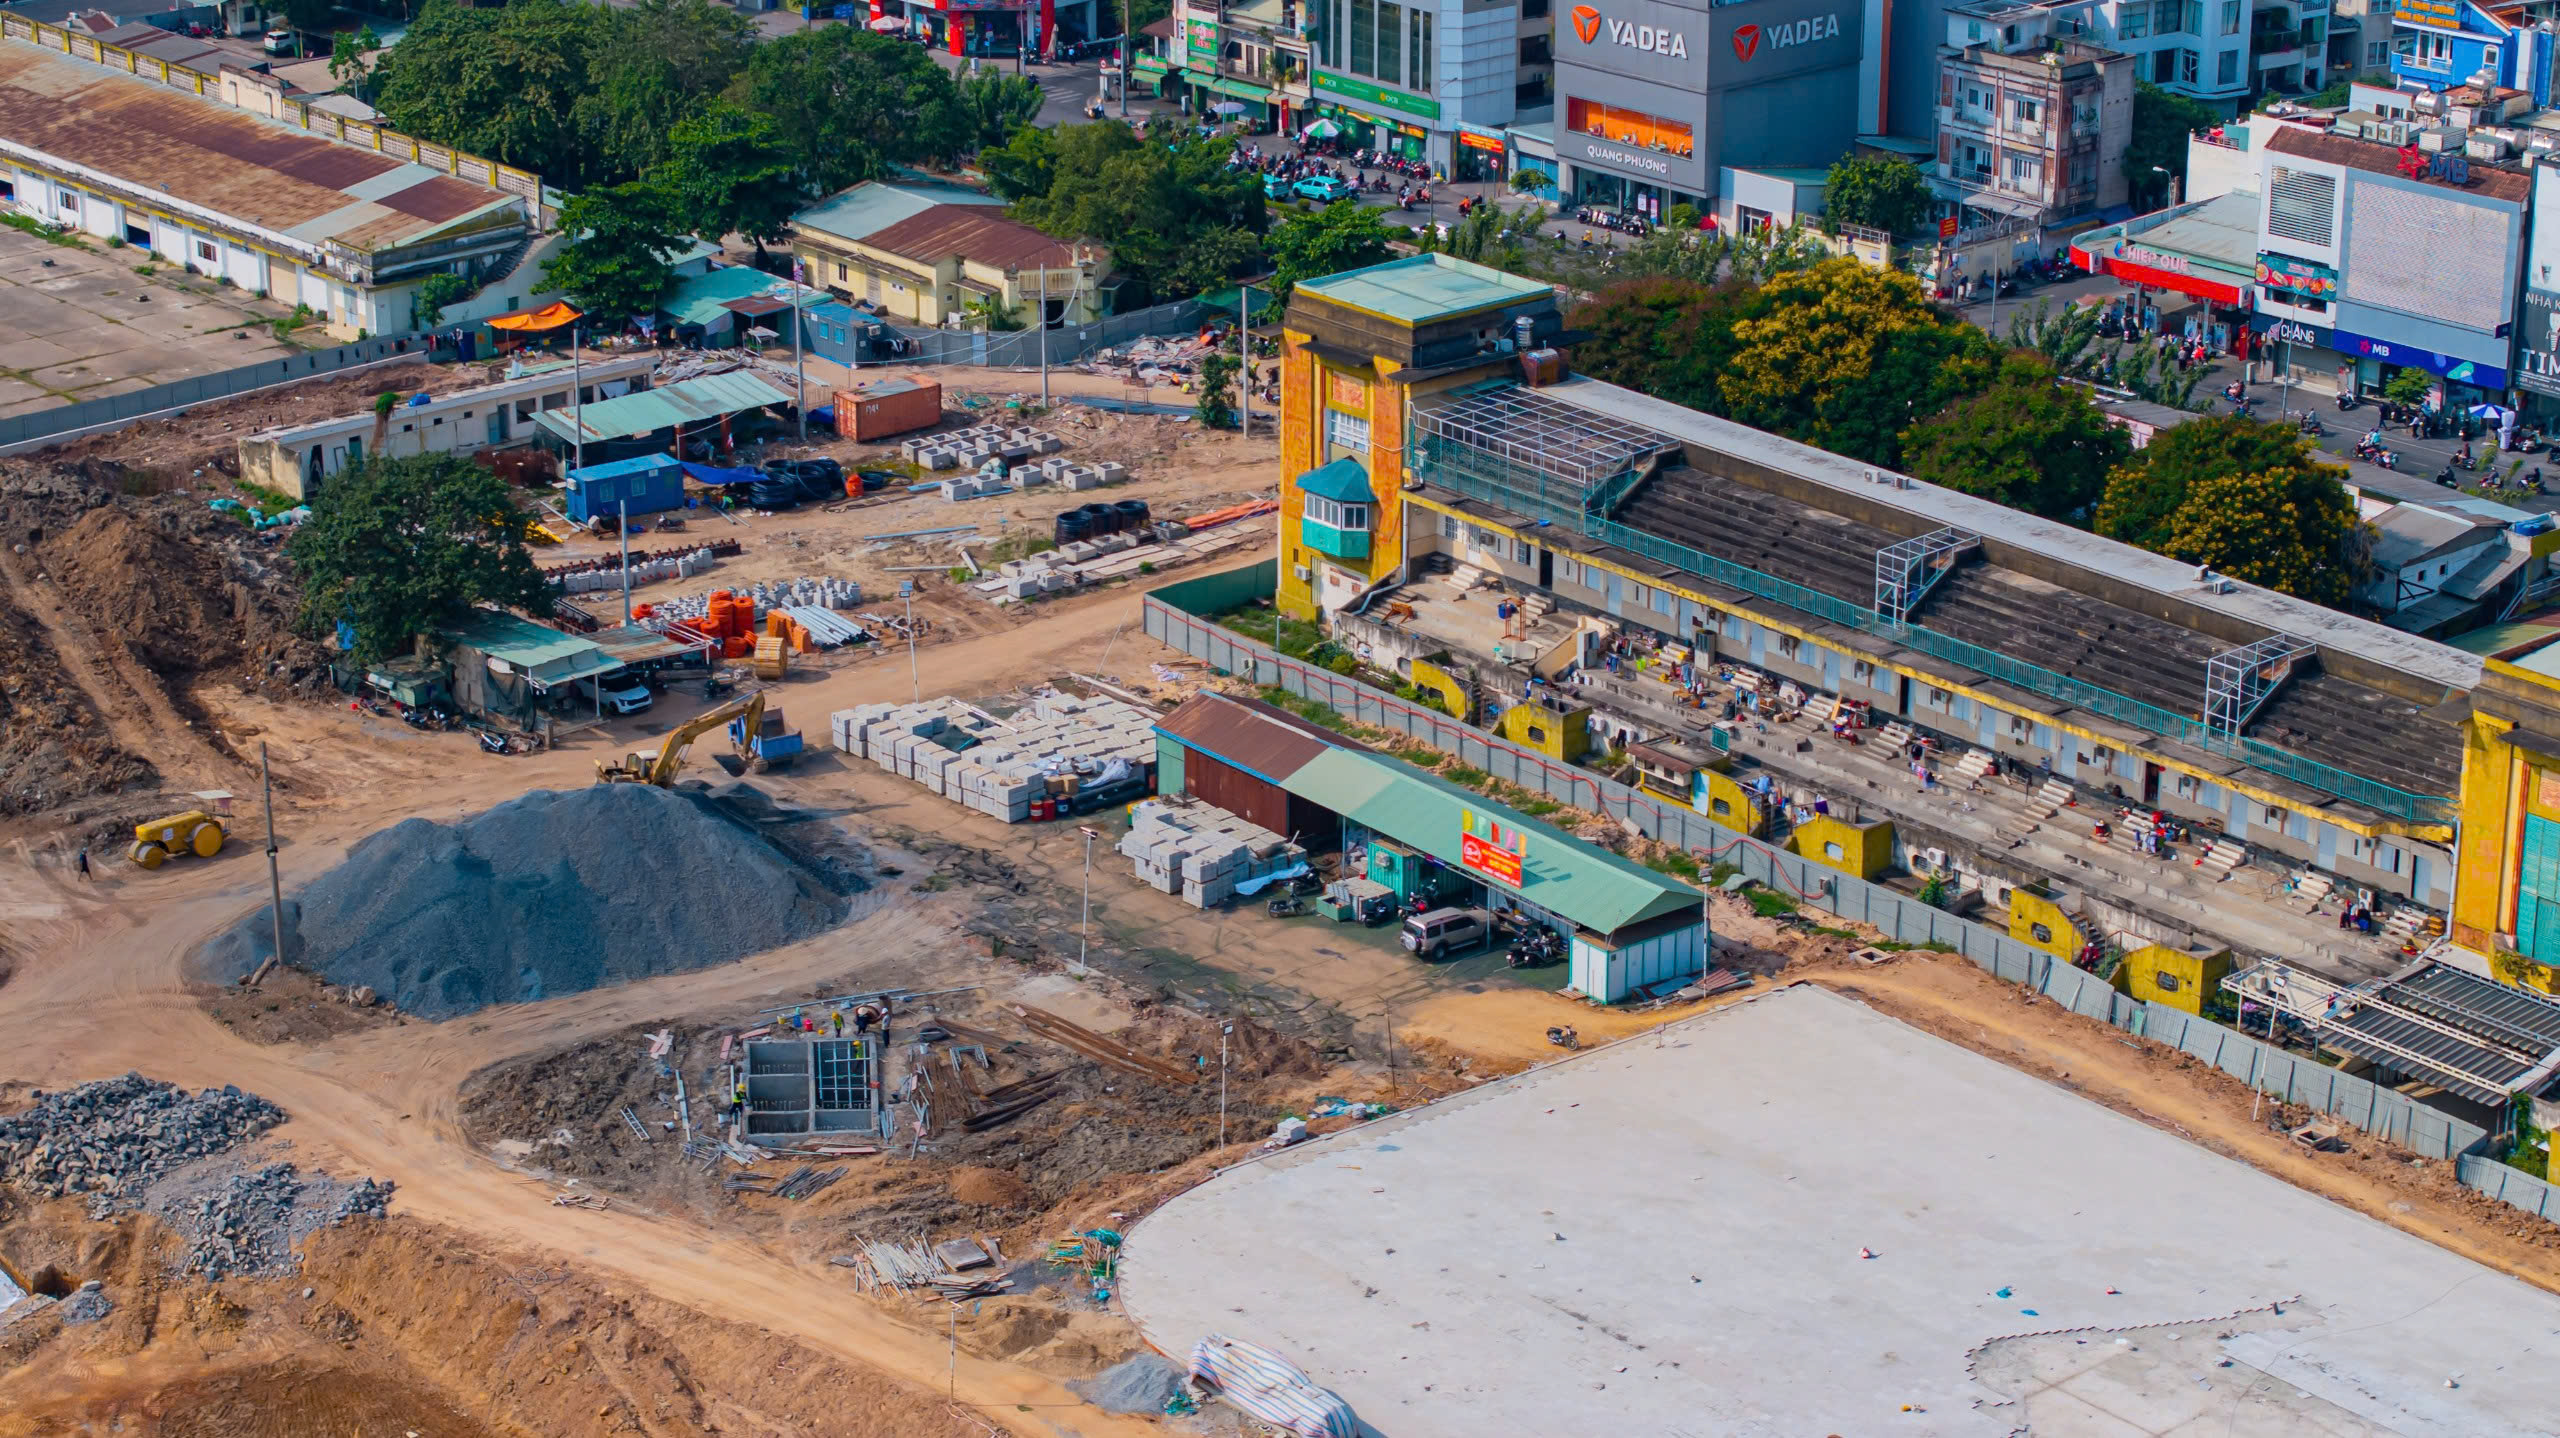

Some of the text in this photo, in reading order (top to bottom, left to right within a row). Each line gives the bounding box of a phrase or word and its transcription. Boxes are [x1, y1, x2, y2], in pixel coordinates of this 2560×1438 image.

[1607, 18, 1688, 60] YADEA
[1767, 14, 1840, 49] YADEA
[1587, 144, 1668, 175] QUANG PHƯƠNG
[2429, 153, 2469, 184] MB
[2525, 292, 2552, 310] NHA
[2280, 323, 2315, 344] CHANG
[2371, 343, 2390, 357] MB
